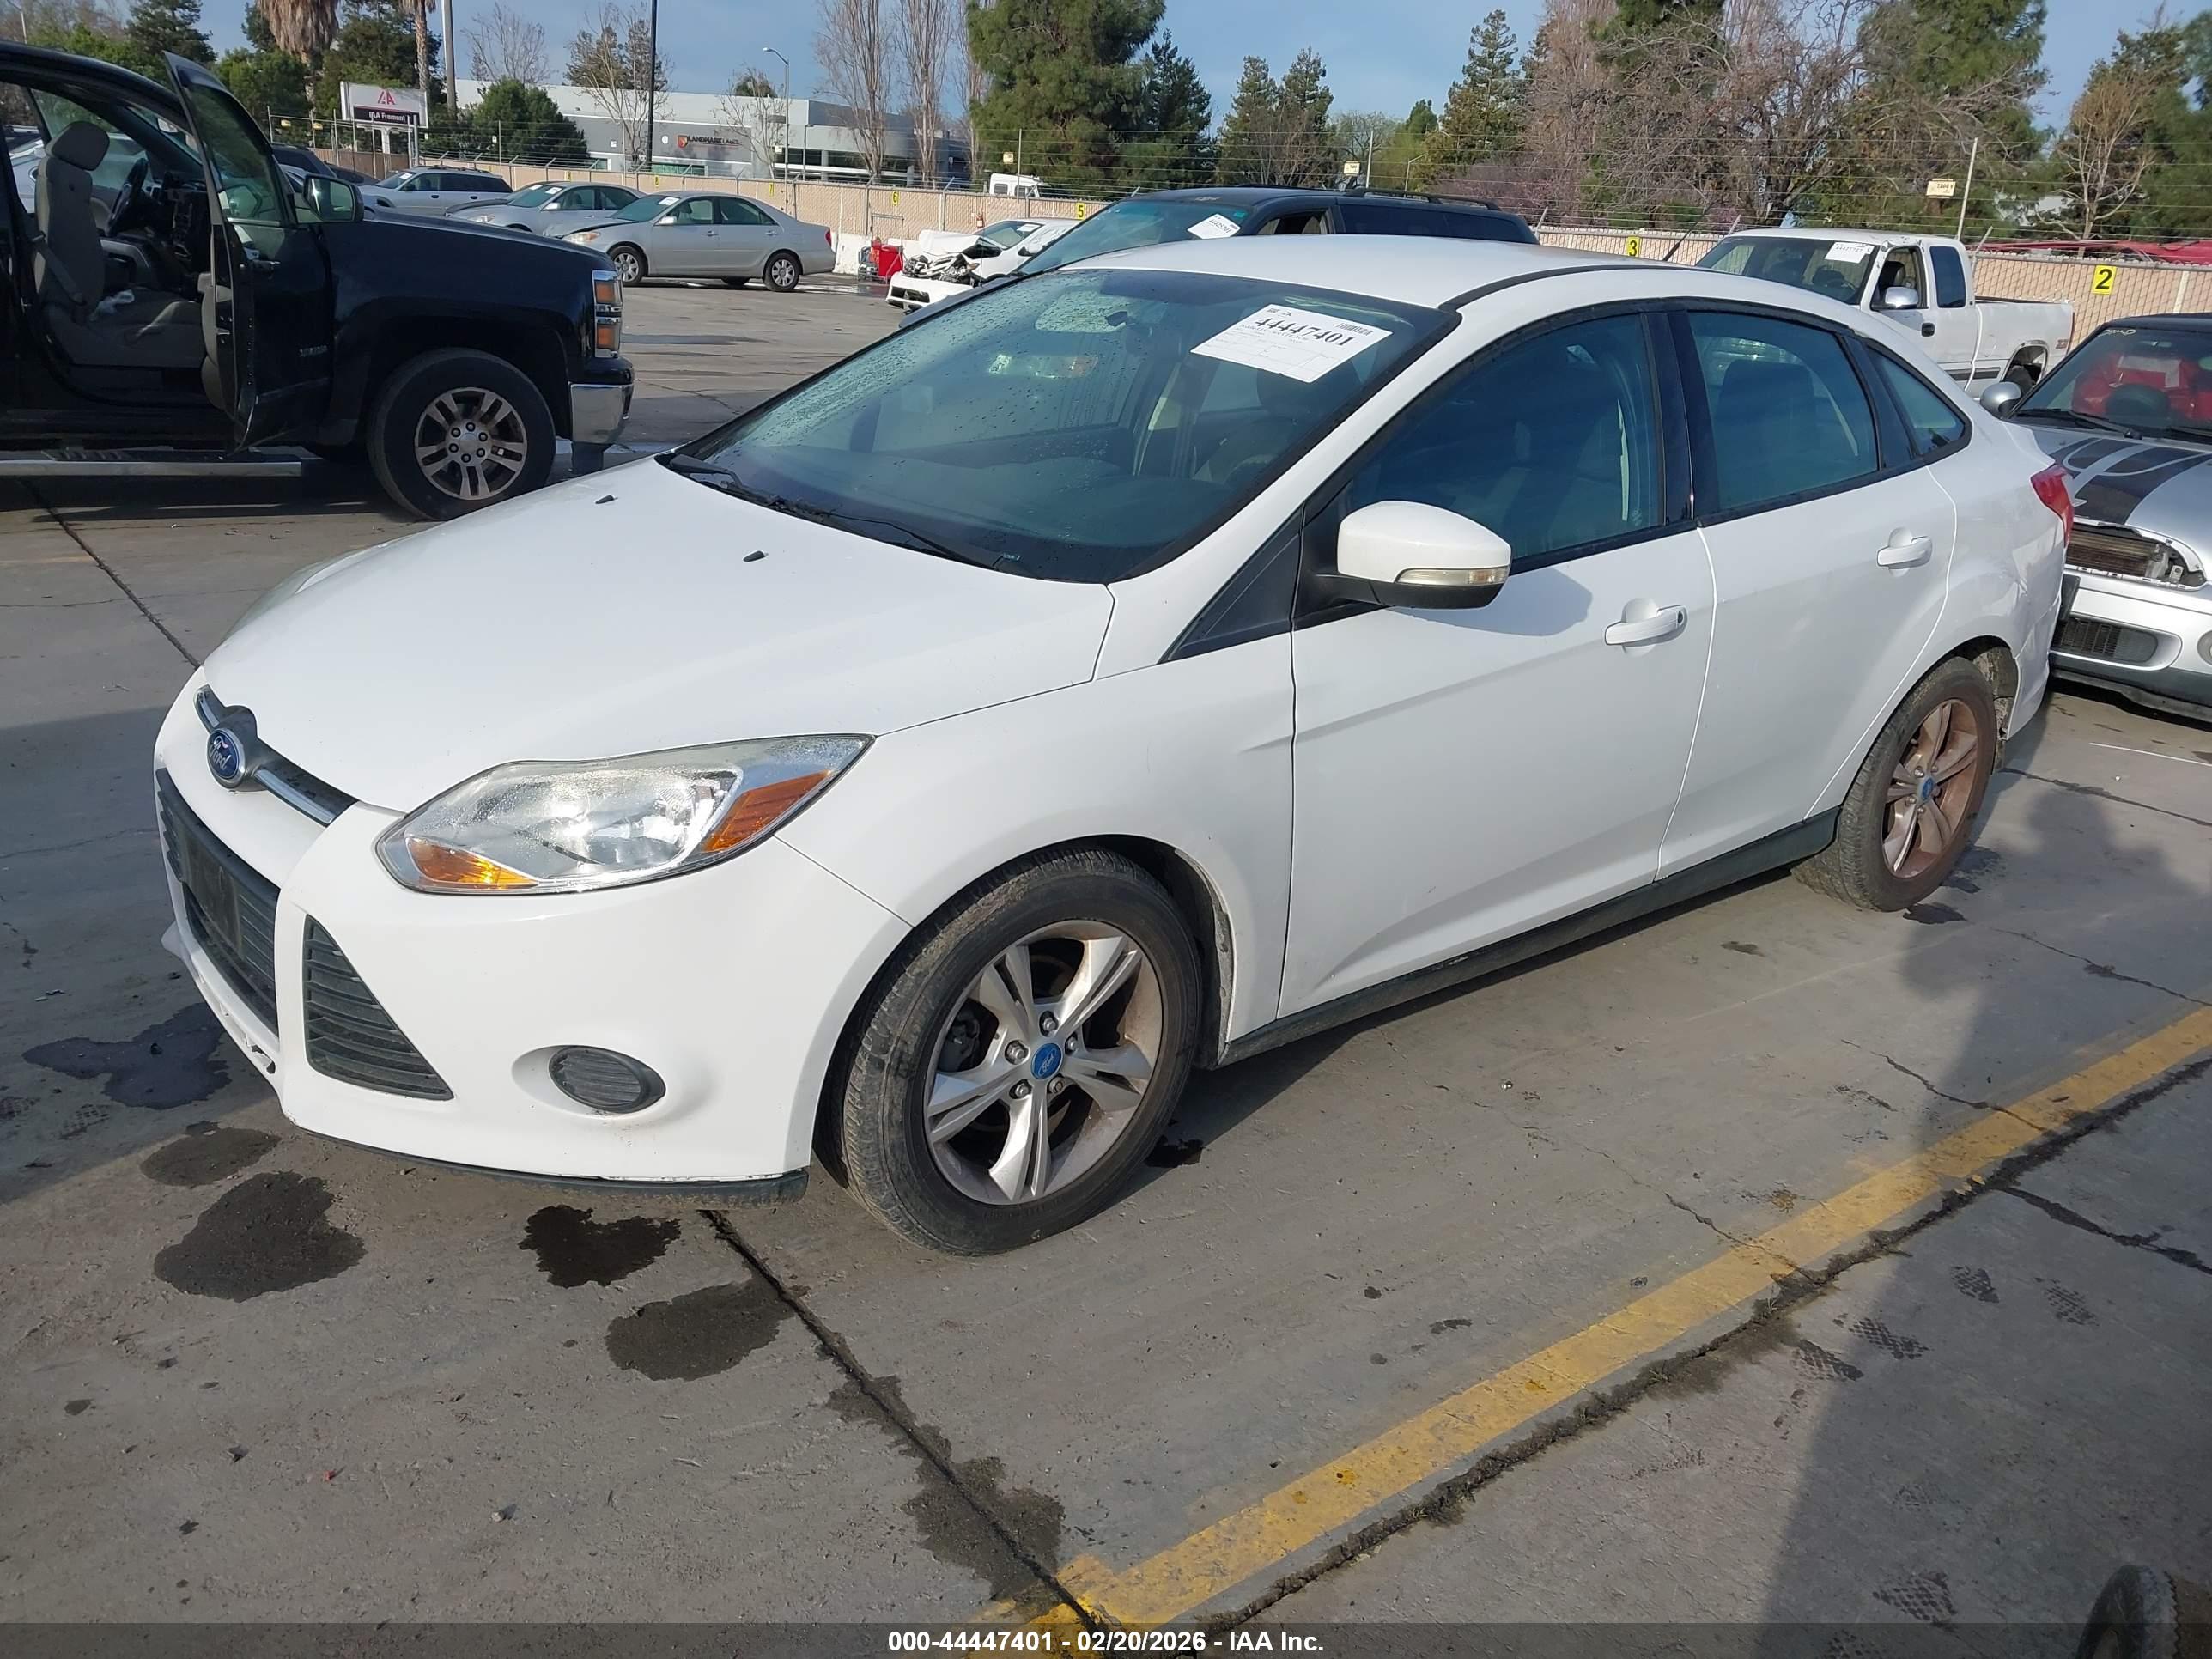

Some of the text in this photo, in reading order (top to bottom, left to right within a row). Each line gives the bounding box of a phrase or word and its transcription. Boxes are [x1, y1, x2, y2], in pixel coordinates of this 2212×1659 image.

[381, 112, 406, 122] Fremont
[892, 191, 898, 203] 6
[1077, 204, 1085, 218] 5
[1628, 240, 1638, 257] 3
[2095, 268, 2113, 291] 2
[1255, 317, 1356, 346] 44447401
[209, 735, 232, 770] Ford
